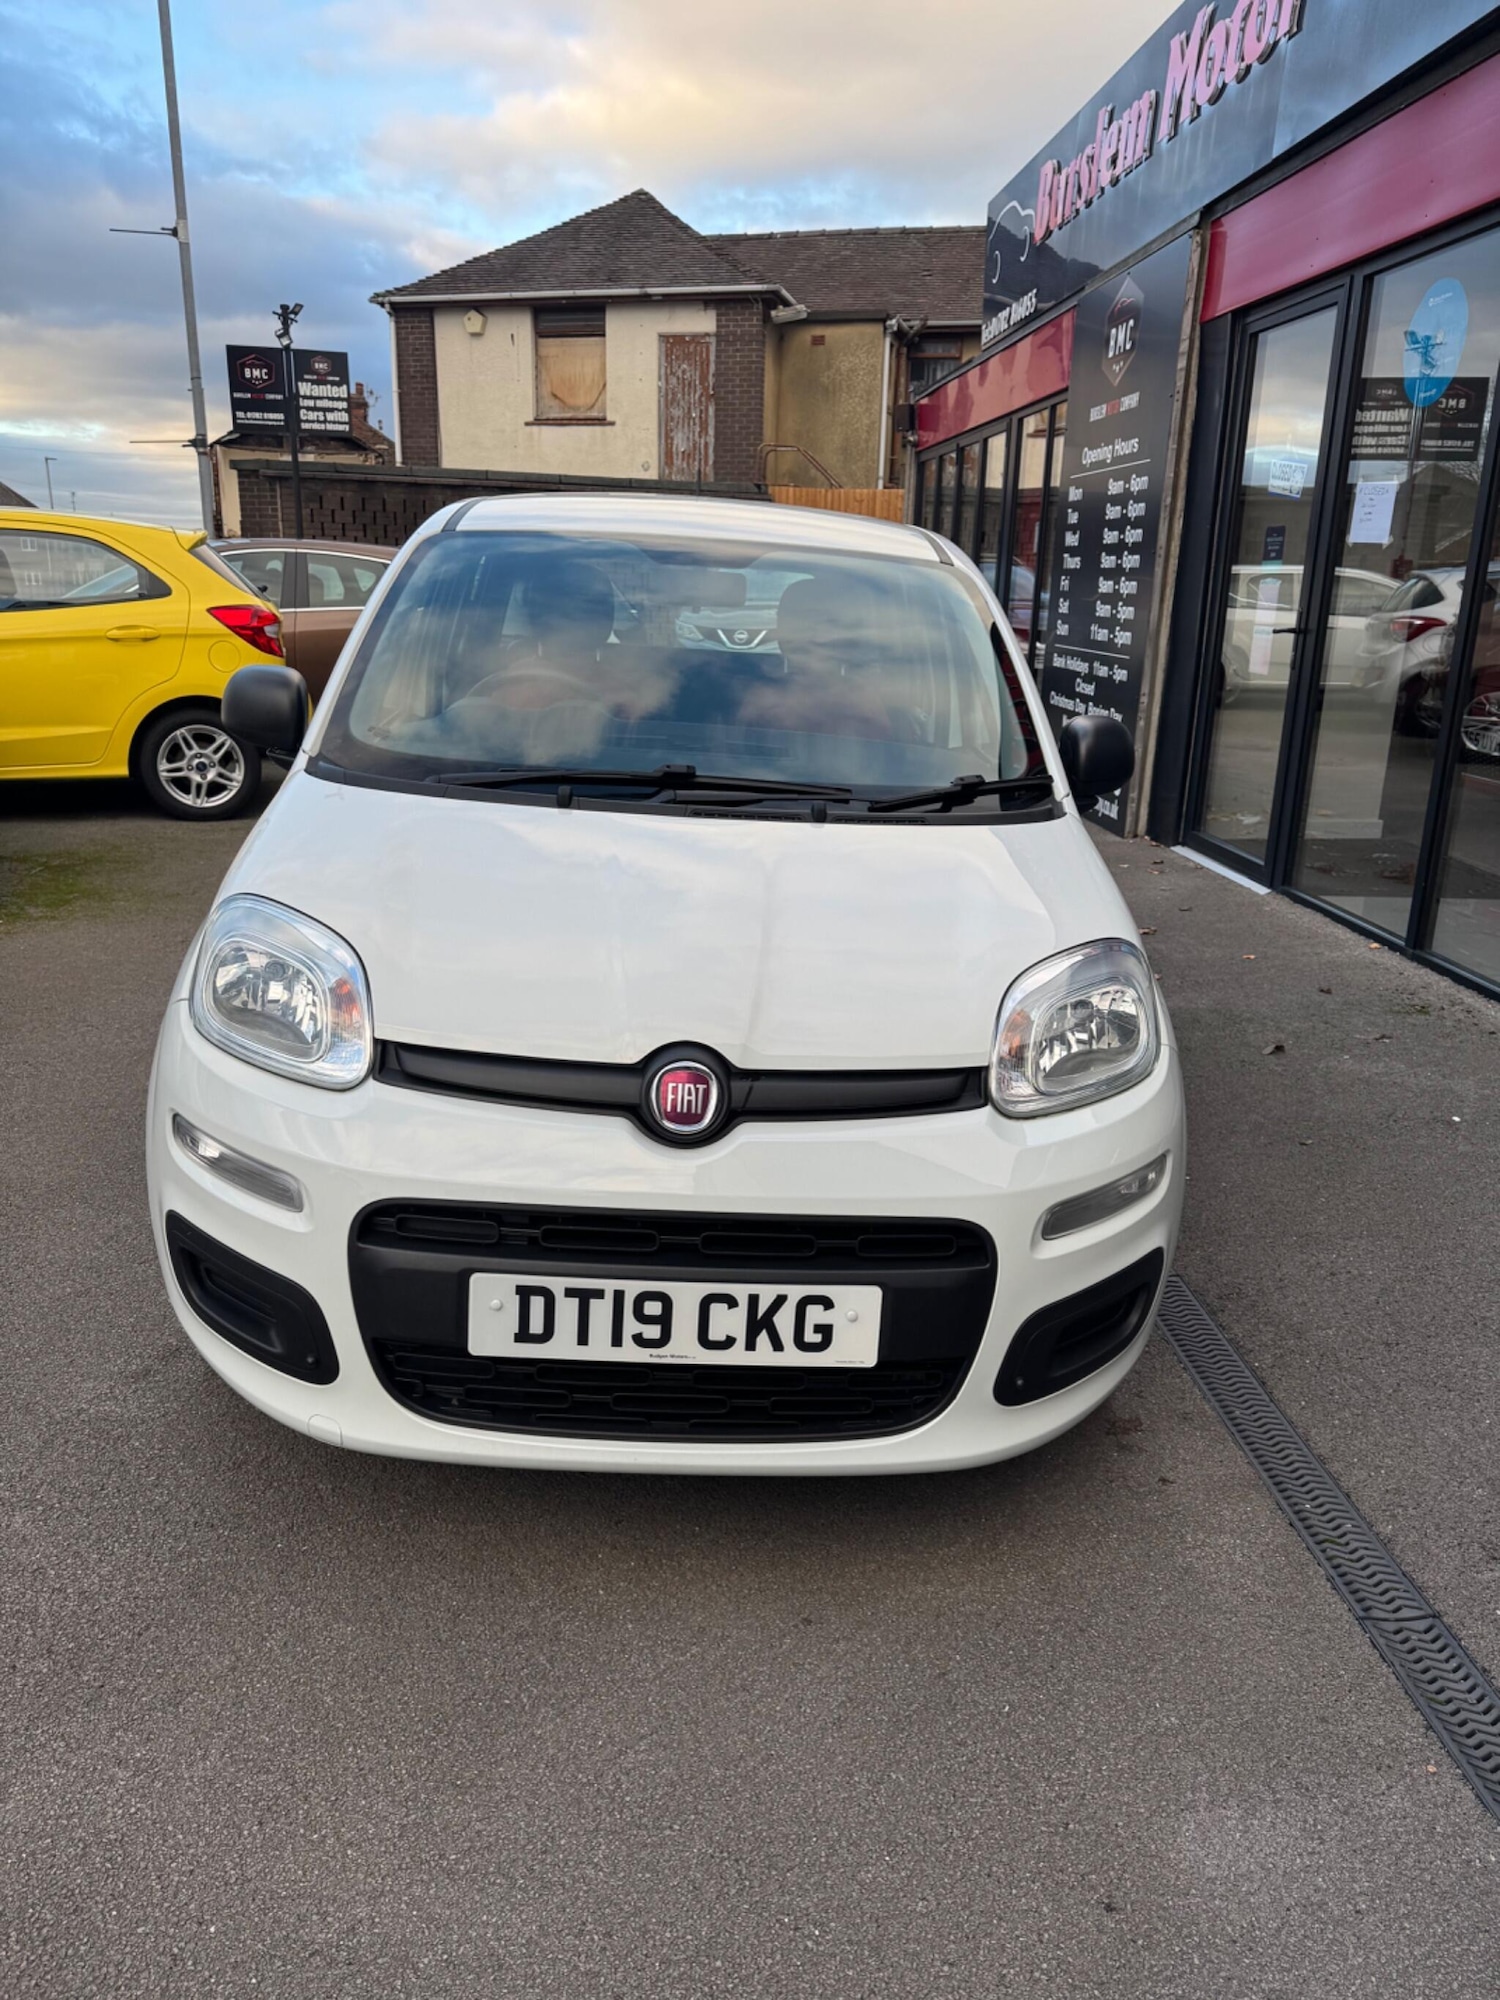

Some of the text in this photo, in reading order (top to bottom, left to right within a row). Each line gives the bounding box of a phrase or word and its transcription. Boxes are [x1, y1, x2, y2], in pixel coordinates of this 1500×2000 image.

[1108, 318, 1135, 359] BMC
[244, 368, 268, 379] BMC
[314, 362, 328, 370] BMC
[297, 381, 348, 398] Wanted
[299, 398, 348, 409] Low mileage
[300, 408, 349, 422] Cars with
[300, 422, 350, 432] service history
[1082, 438, 1140, 468] Opening Hours
[1068, 486, 1083, 502] Mon
[1107, 478, 1124, 496] 9am
[1130, 473, 1149, 496] 6pm
[1067, 508, 1079, 524] Tue
[1105, 503, 1122, 520] 9am
[1127, 500, 1146, 522] 6pm
[1064, 530, 1080, 547] Wed
[1103, 527, 1119, 544] 9am
[1124, 525, 1143, 547] 6pm
[1063, 553, 1081, 569] Thurs
[1100, 551, 1117, 569] 9am
[1122, 550, 1141, 573] 6pm
[1060, 575, 1070, 592] Fri
[1098, 576, 1114, 593] 9am
[1119, 576, 1138, 599] 6pm
[1058, 598, 1069, 614] Sat
[1095, 600, 1112, 617] 9am
[1116, 601, 1135, 624] 5pm
[1056, 619, 1069, 636] Sun
[1090, 623, 1109, 642] 11am
[1114, 626, 1132, 648] 5pm
[1052, 652, 1066, 669] Bank
[1066, 655, 1089, 677] Holidays
[1093, 660, 1109, 678] 11am
[1112, 664, 1128, 684] 5pm
[1075, 677, 1096, 696] Closed
[1049, 690, 1075, 711] Christmas
[1075, 698, 1087, 716] Day
[1109, 707, 1123, 722] Day
[667, 1082, 707, 1115] FIAT
[513, 1284, 835, 1353] DT19 CKG
